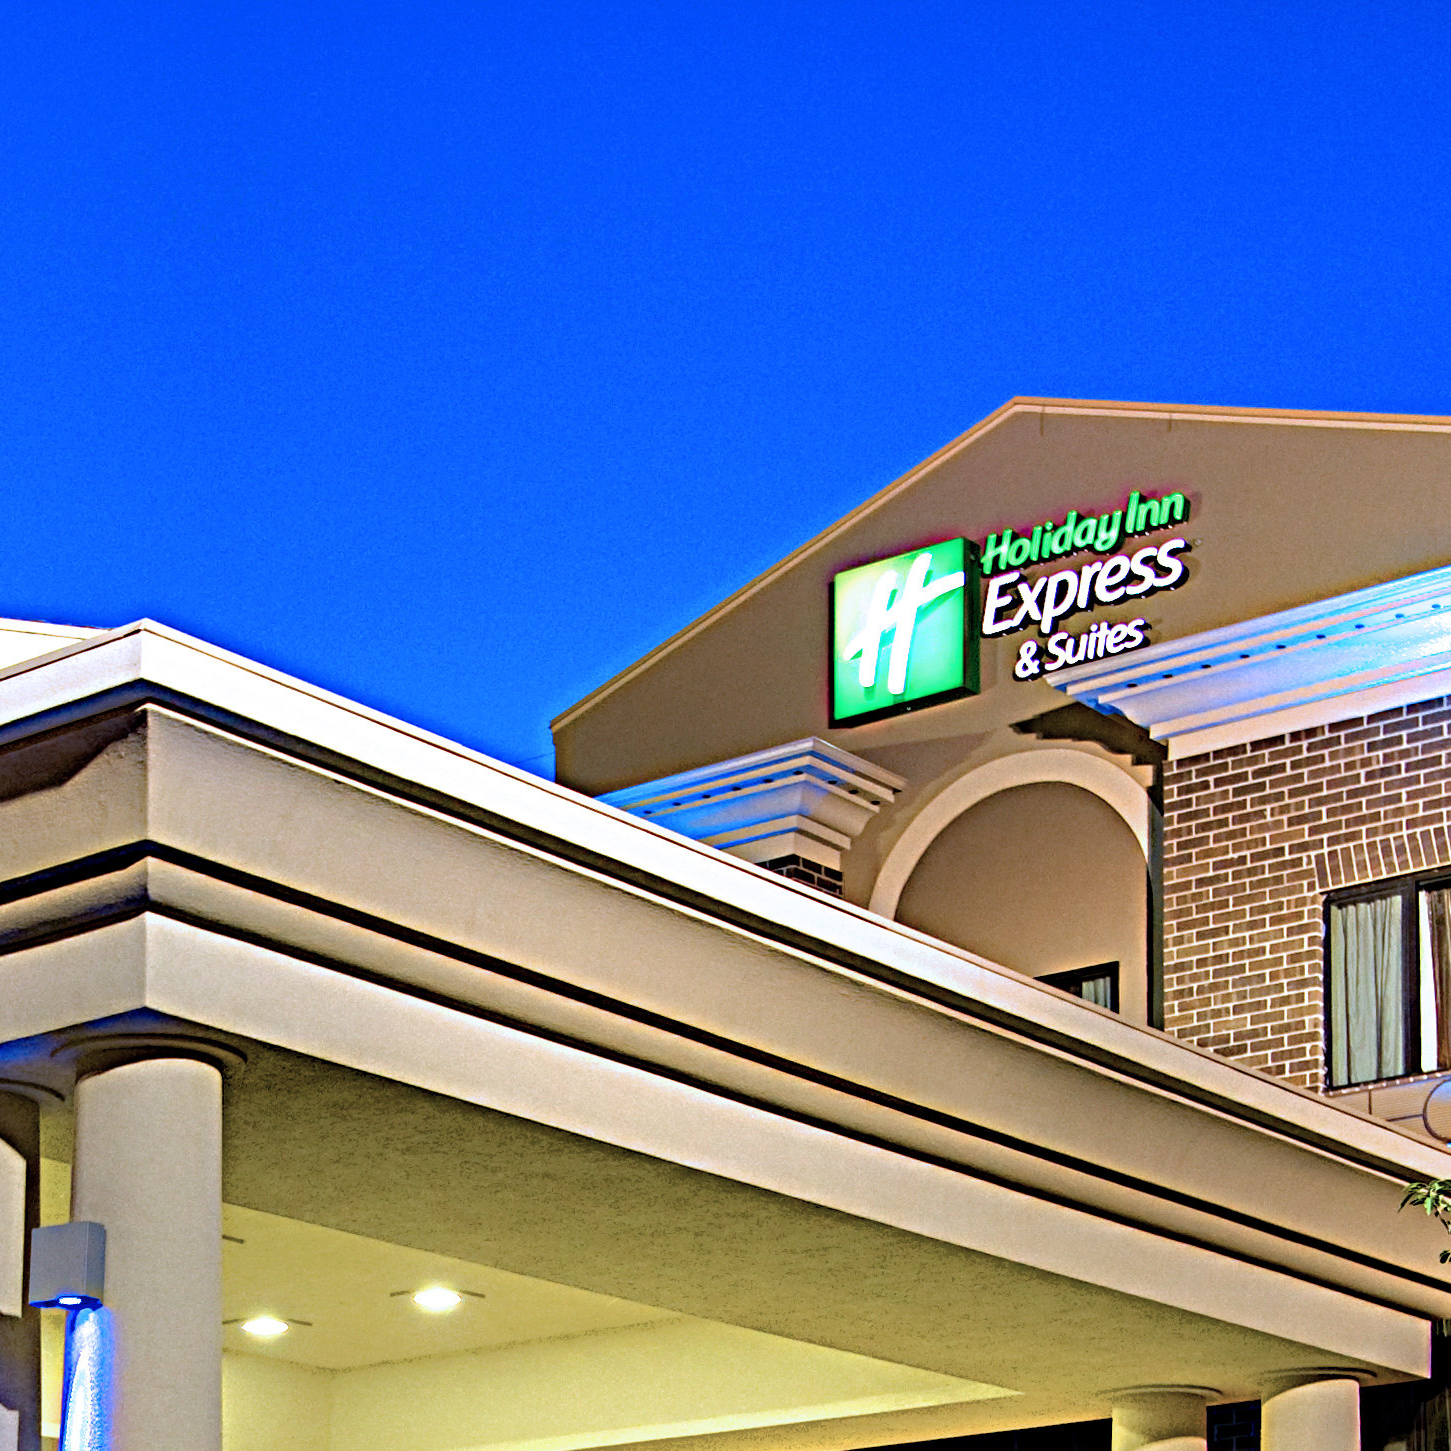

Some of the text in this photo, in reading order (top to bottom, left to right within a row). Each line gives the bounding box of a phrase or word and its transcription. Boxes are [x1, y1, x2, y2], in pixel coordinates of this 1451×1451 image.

[981, 491, 1186, 576] Holiday Inn
[981, 539, 1187, 636] Express
[1014, 618, 1148, 679] & Suites
